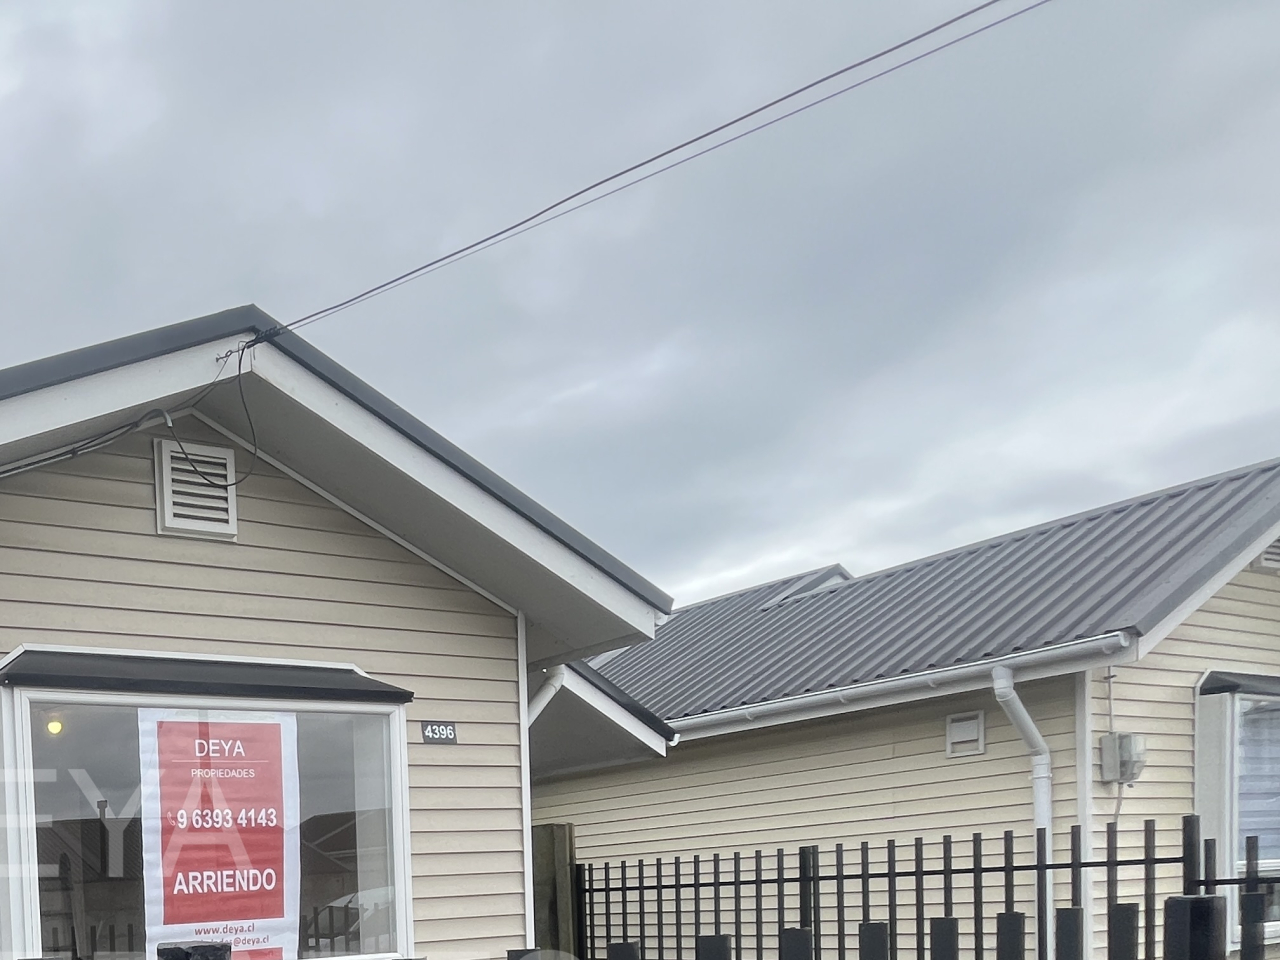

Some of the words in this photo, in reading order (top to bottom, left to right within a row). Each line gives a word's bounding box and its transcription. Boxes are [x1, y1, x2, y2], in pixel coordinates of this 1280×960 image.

[424, 724, 455, 739] 4396
[195, 739, 246, 757] DEYA
[191, 768, 256, 778] PROPIEDADES
[177, 809, 188, 829] 9
[192, 808, 233, 829] 6393
[237, 808, 277, 828] 4143
[173, 868, 277, 895] ARRIENDO
[194, 922, 255, 936] www.deya.cl
